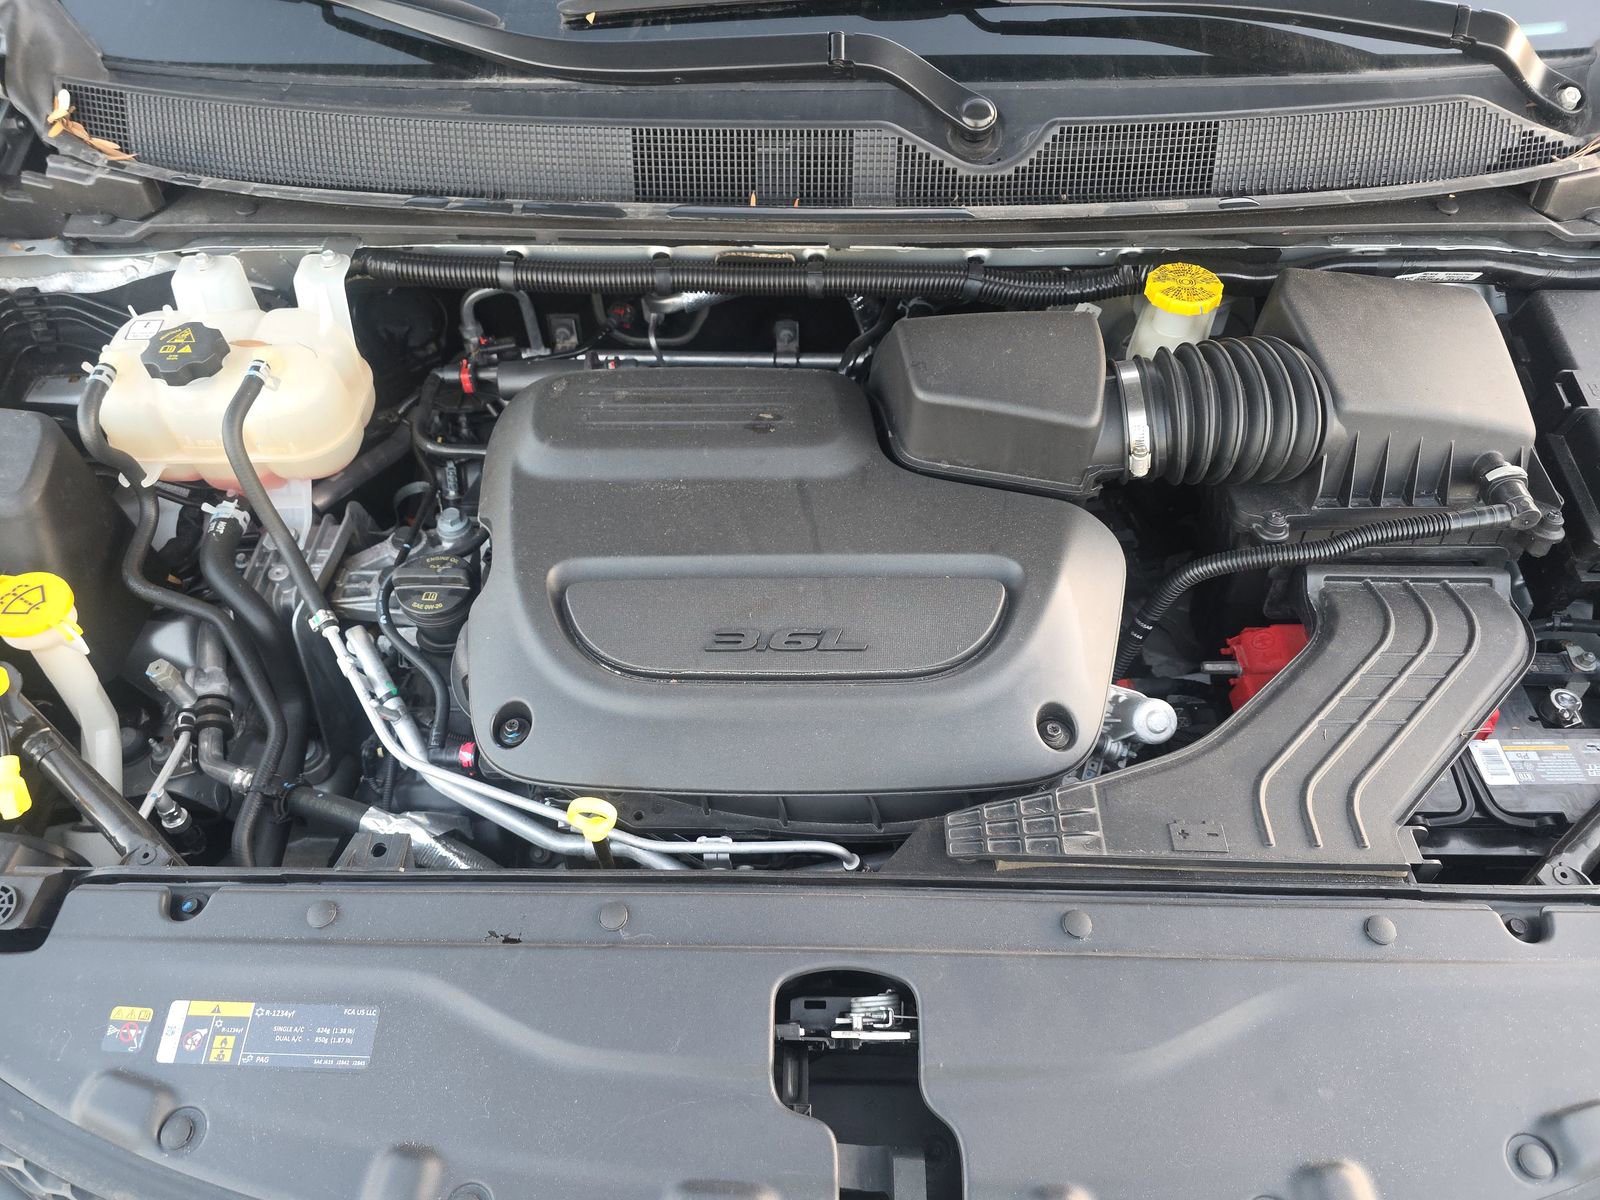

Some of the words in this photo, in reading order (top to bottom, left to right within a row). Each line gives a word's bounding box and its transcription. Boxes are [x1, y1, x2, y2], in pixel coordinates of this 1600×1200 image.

[704, 627, 869, 653] 3.6L
[265, 1009, 296, 1019] R-1234yf
[343, 1008, 356, 1016] FCA
[294, 1026, 305, 1034] A/C
[255, 1056, 270, 1064] PAG
